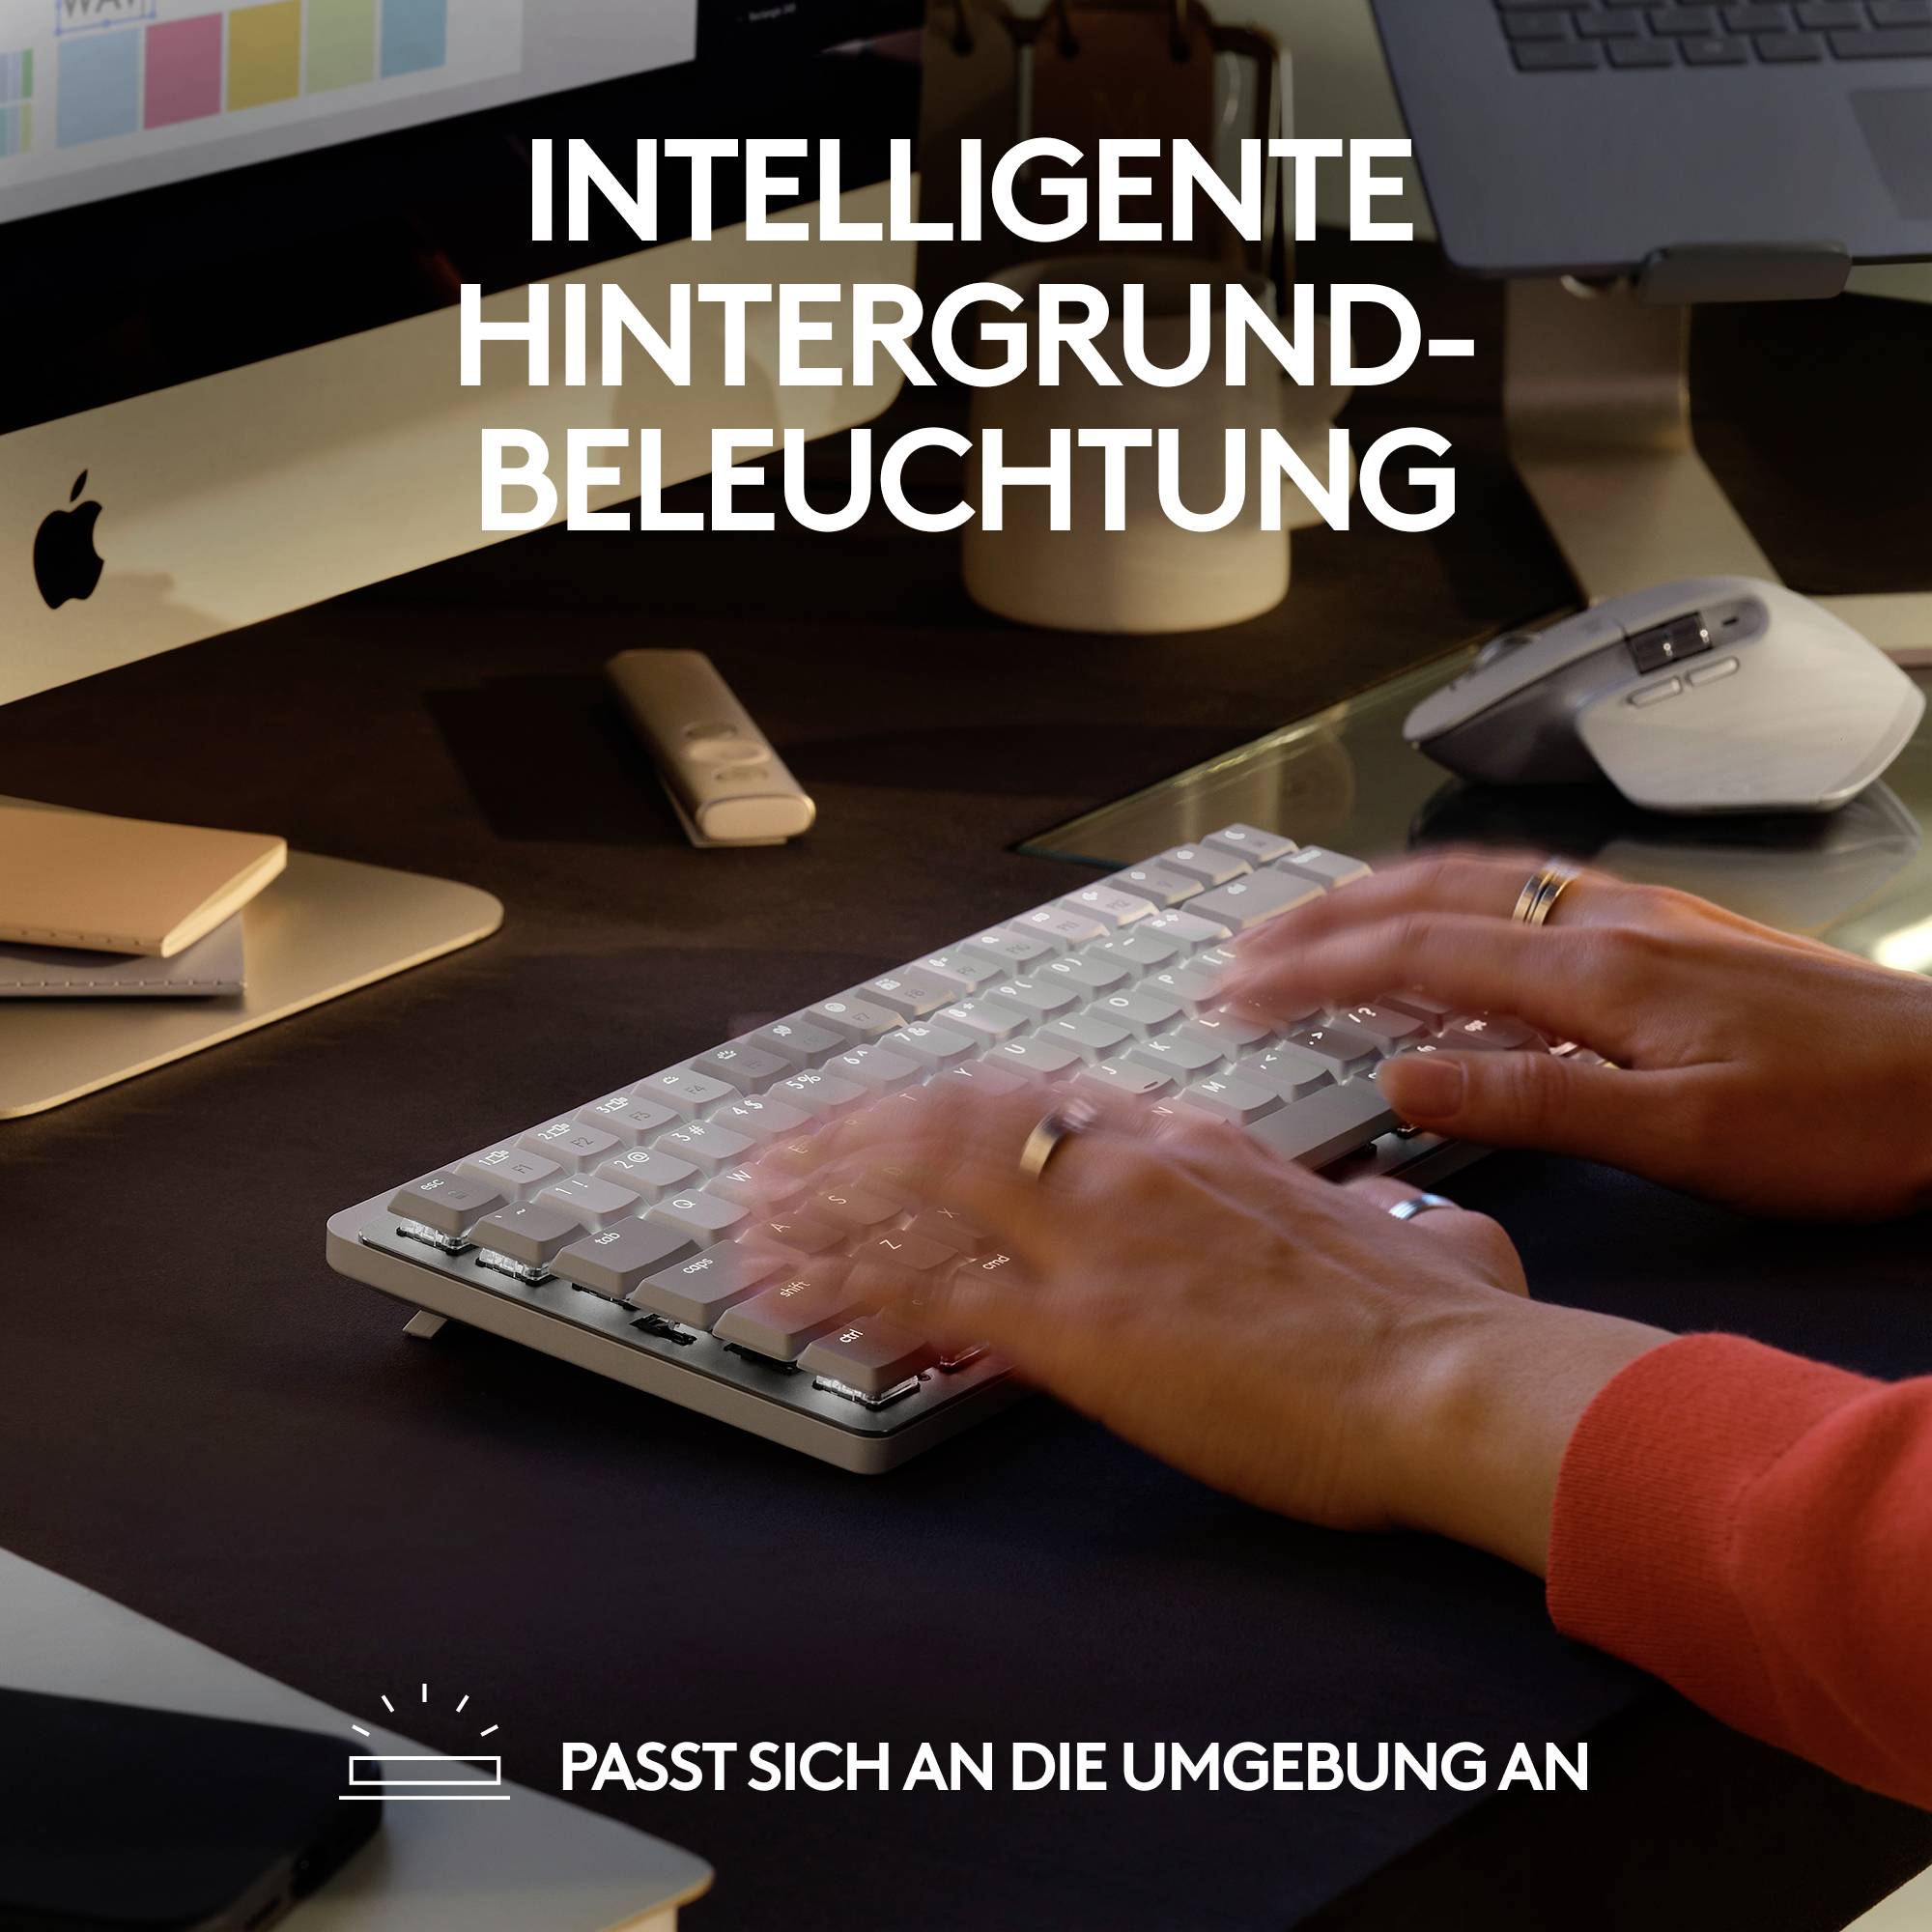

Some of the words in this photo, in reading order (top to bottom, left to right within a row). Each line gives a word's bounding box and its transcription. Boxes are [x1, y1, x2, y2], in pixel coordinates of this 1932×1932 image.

[1157, 975, 1175, 984] P
[1005, 1043, 1026, 1054] U
[1149, 1041, 1171, 1051] K
[952, 1067, 973, 1078] Y
[785, 1080, 805, 1090] 5
[1202, 1080, 1226, 1094] M
[732, 1106, 749, 1116] 4
[571, 1136, 594, 1148] F2
[671, 1131, 691, 1143] 3
[613, 1159, 634, 1170] 2
[627, 1151, 650, 1163] @
[512, 1164, 534, 1175] F1
[726, 1170, 752, 1182] W
[420, 1179, 445, 1192] esc
[672, 1199, 696, 1209] Q
[828, 1195, 847, 1205] S
[771, 1223, 791, 1233] A
[594, 1233, 620, 1245] tab
[683, 1258, 714, 1274] caps
[982, 1254, 1010, 1270] cmd
[780, 1280, 810, 1297] shift
[839, 1328, 864, 1344] ctrl
